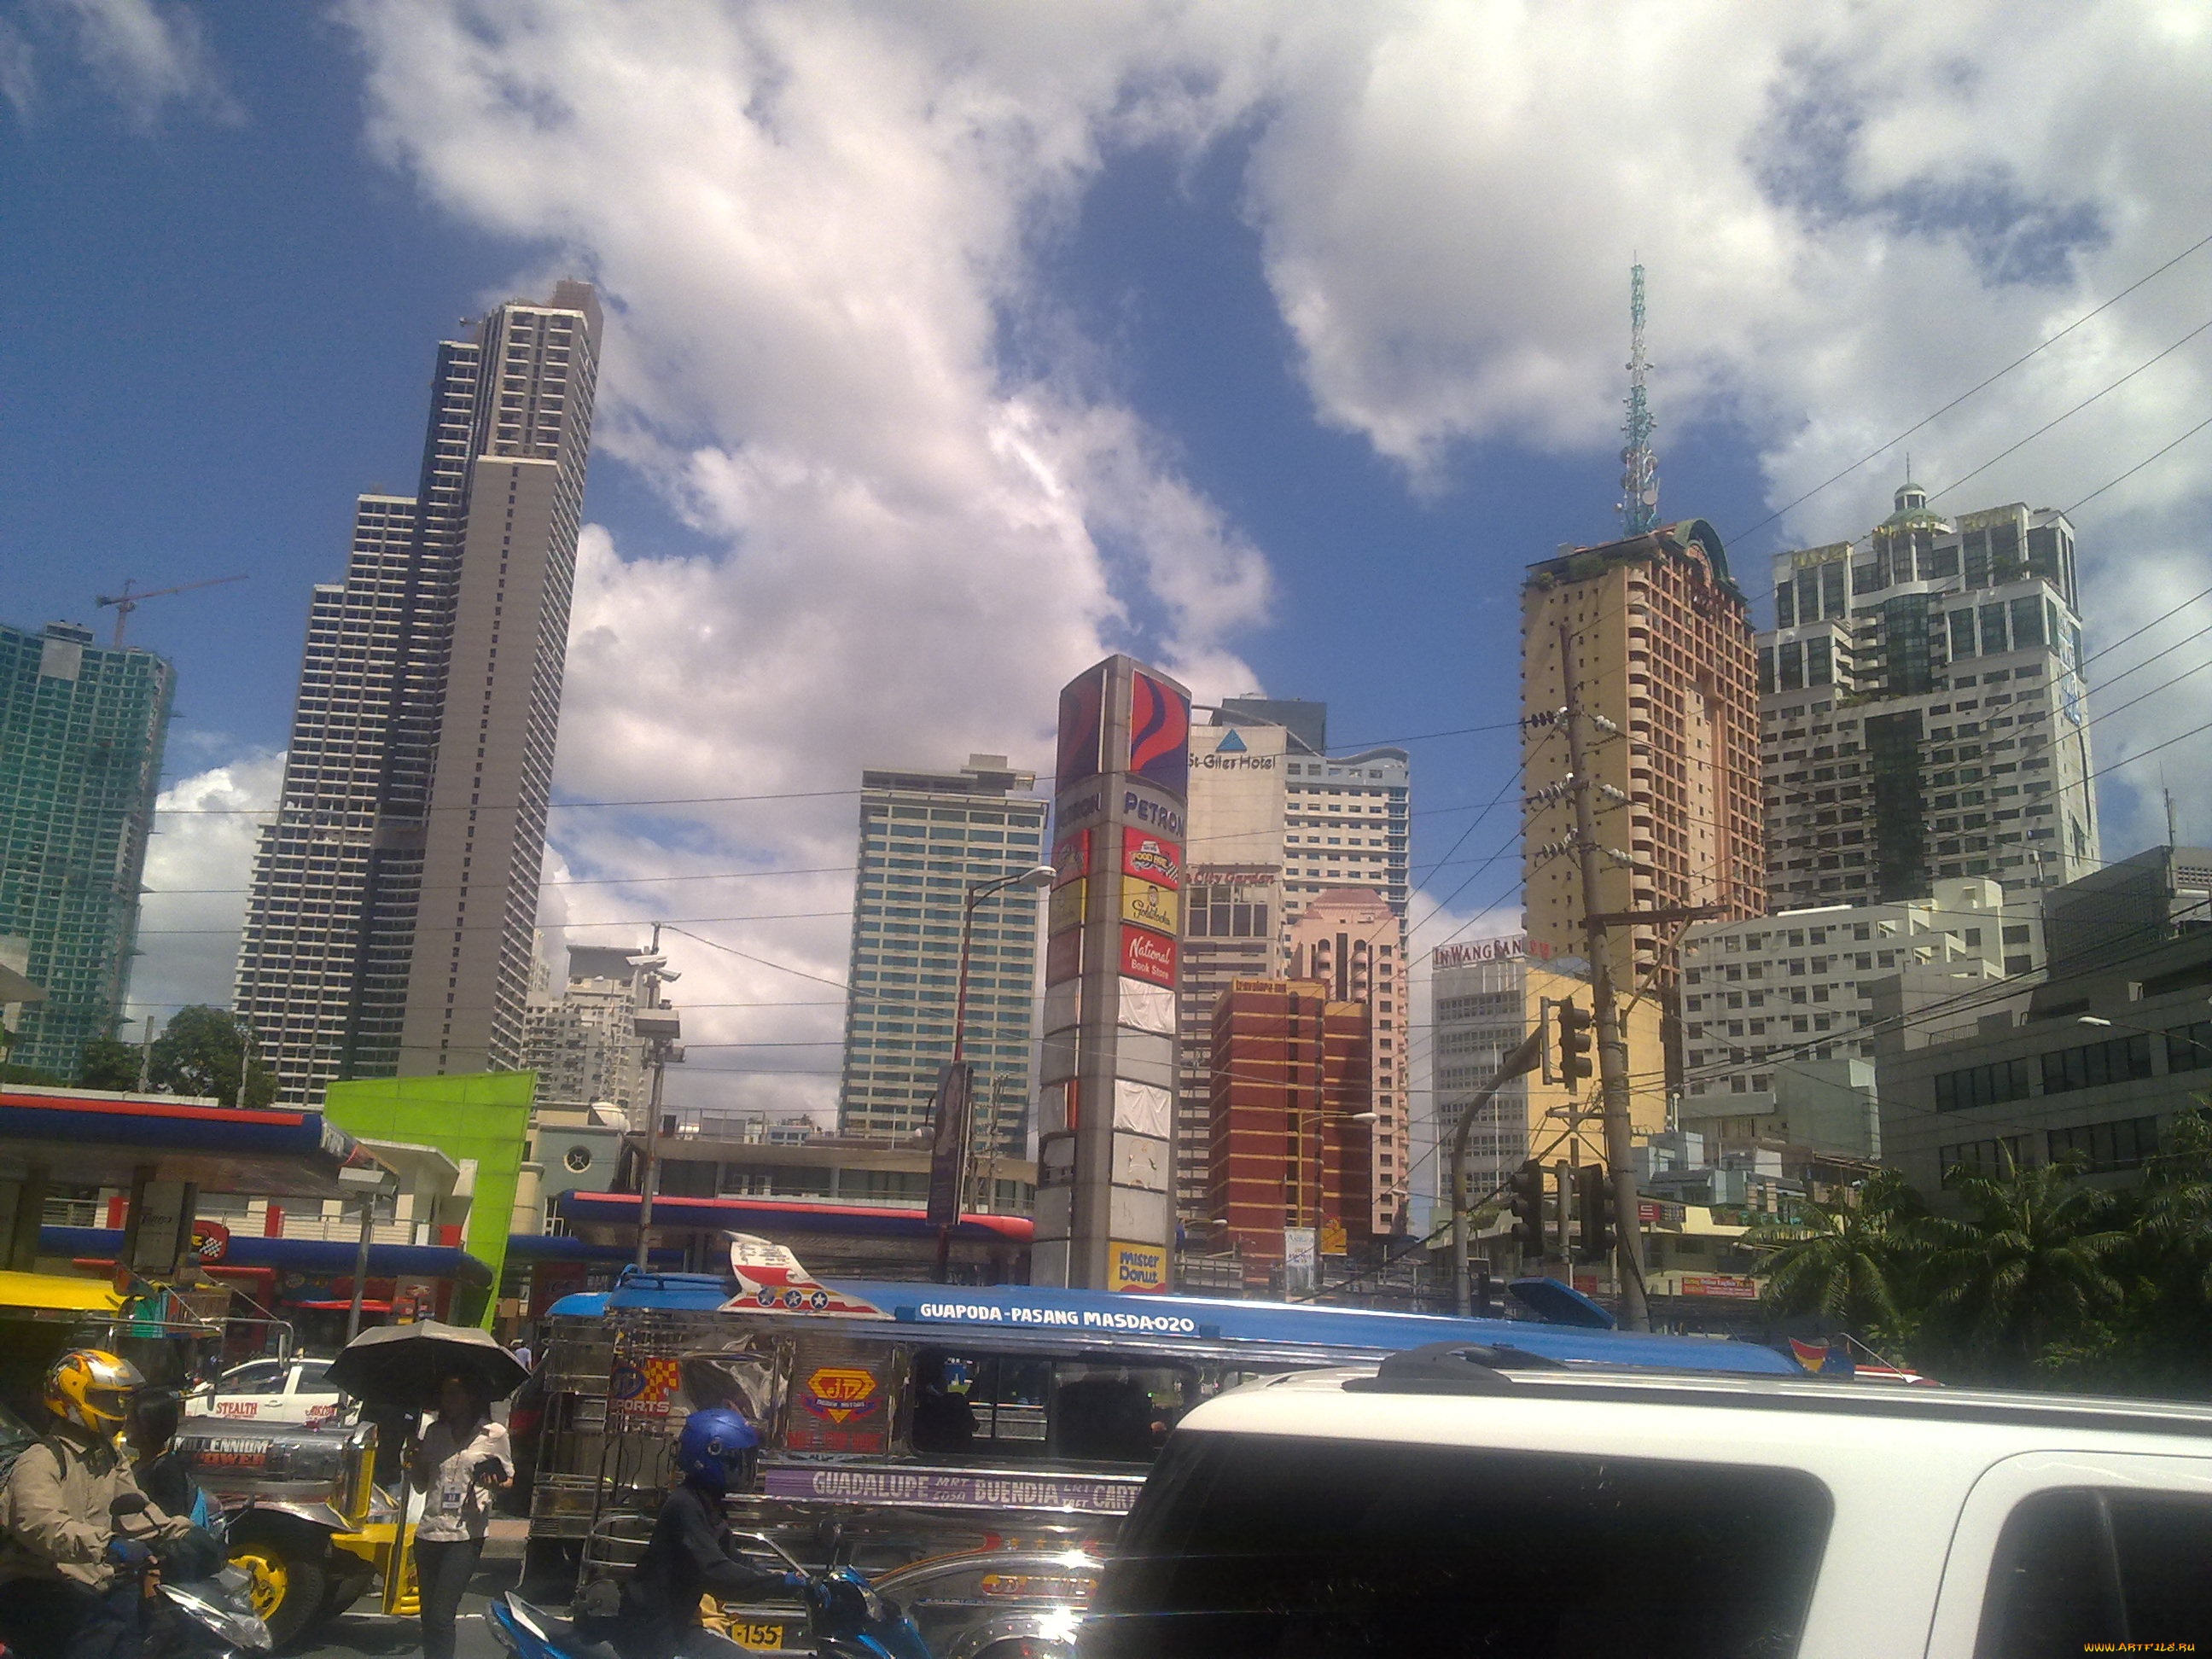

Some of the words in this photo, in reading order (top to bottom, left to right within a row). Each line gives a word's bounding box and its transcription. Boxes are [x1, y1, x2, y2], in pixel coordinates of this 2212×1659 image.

[1240, 755, 1275, 770] Hotel
[1124, 791, 1185, 837] PETRON
[1129, 936, 1171, 963] National
[1132, 958, 1150, 973] Book
[1151, 964, 1169, 979] Store
[1120, 1266, 1158, 1284] Donut
[921, 1303, 1002, 1321] GUAPODA
[217, 1402, 257, 1414] STEALTH
[812, 1470, 929, 1498] GUADALUPE
[935, 1476, 969, 1487] MRT
[975, 1480, 1058, 1505] BUENDIA
[1092, 1485, 1142, 1509] CART
[744, 1625, 778, 1645] 155
